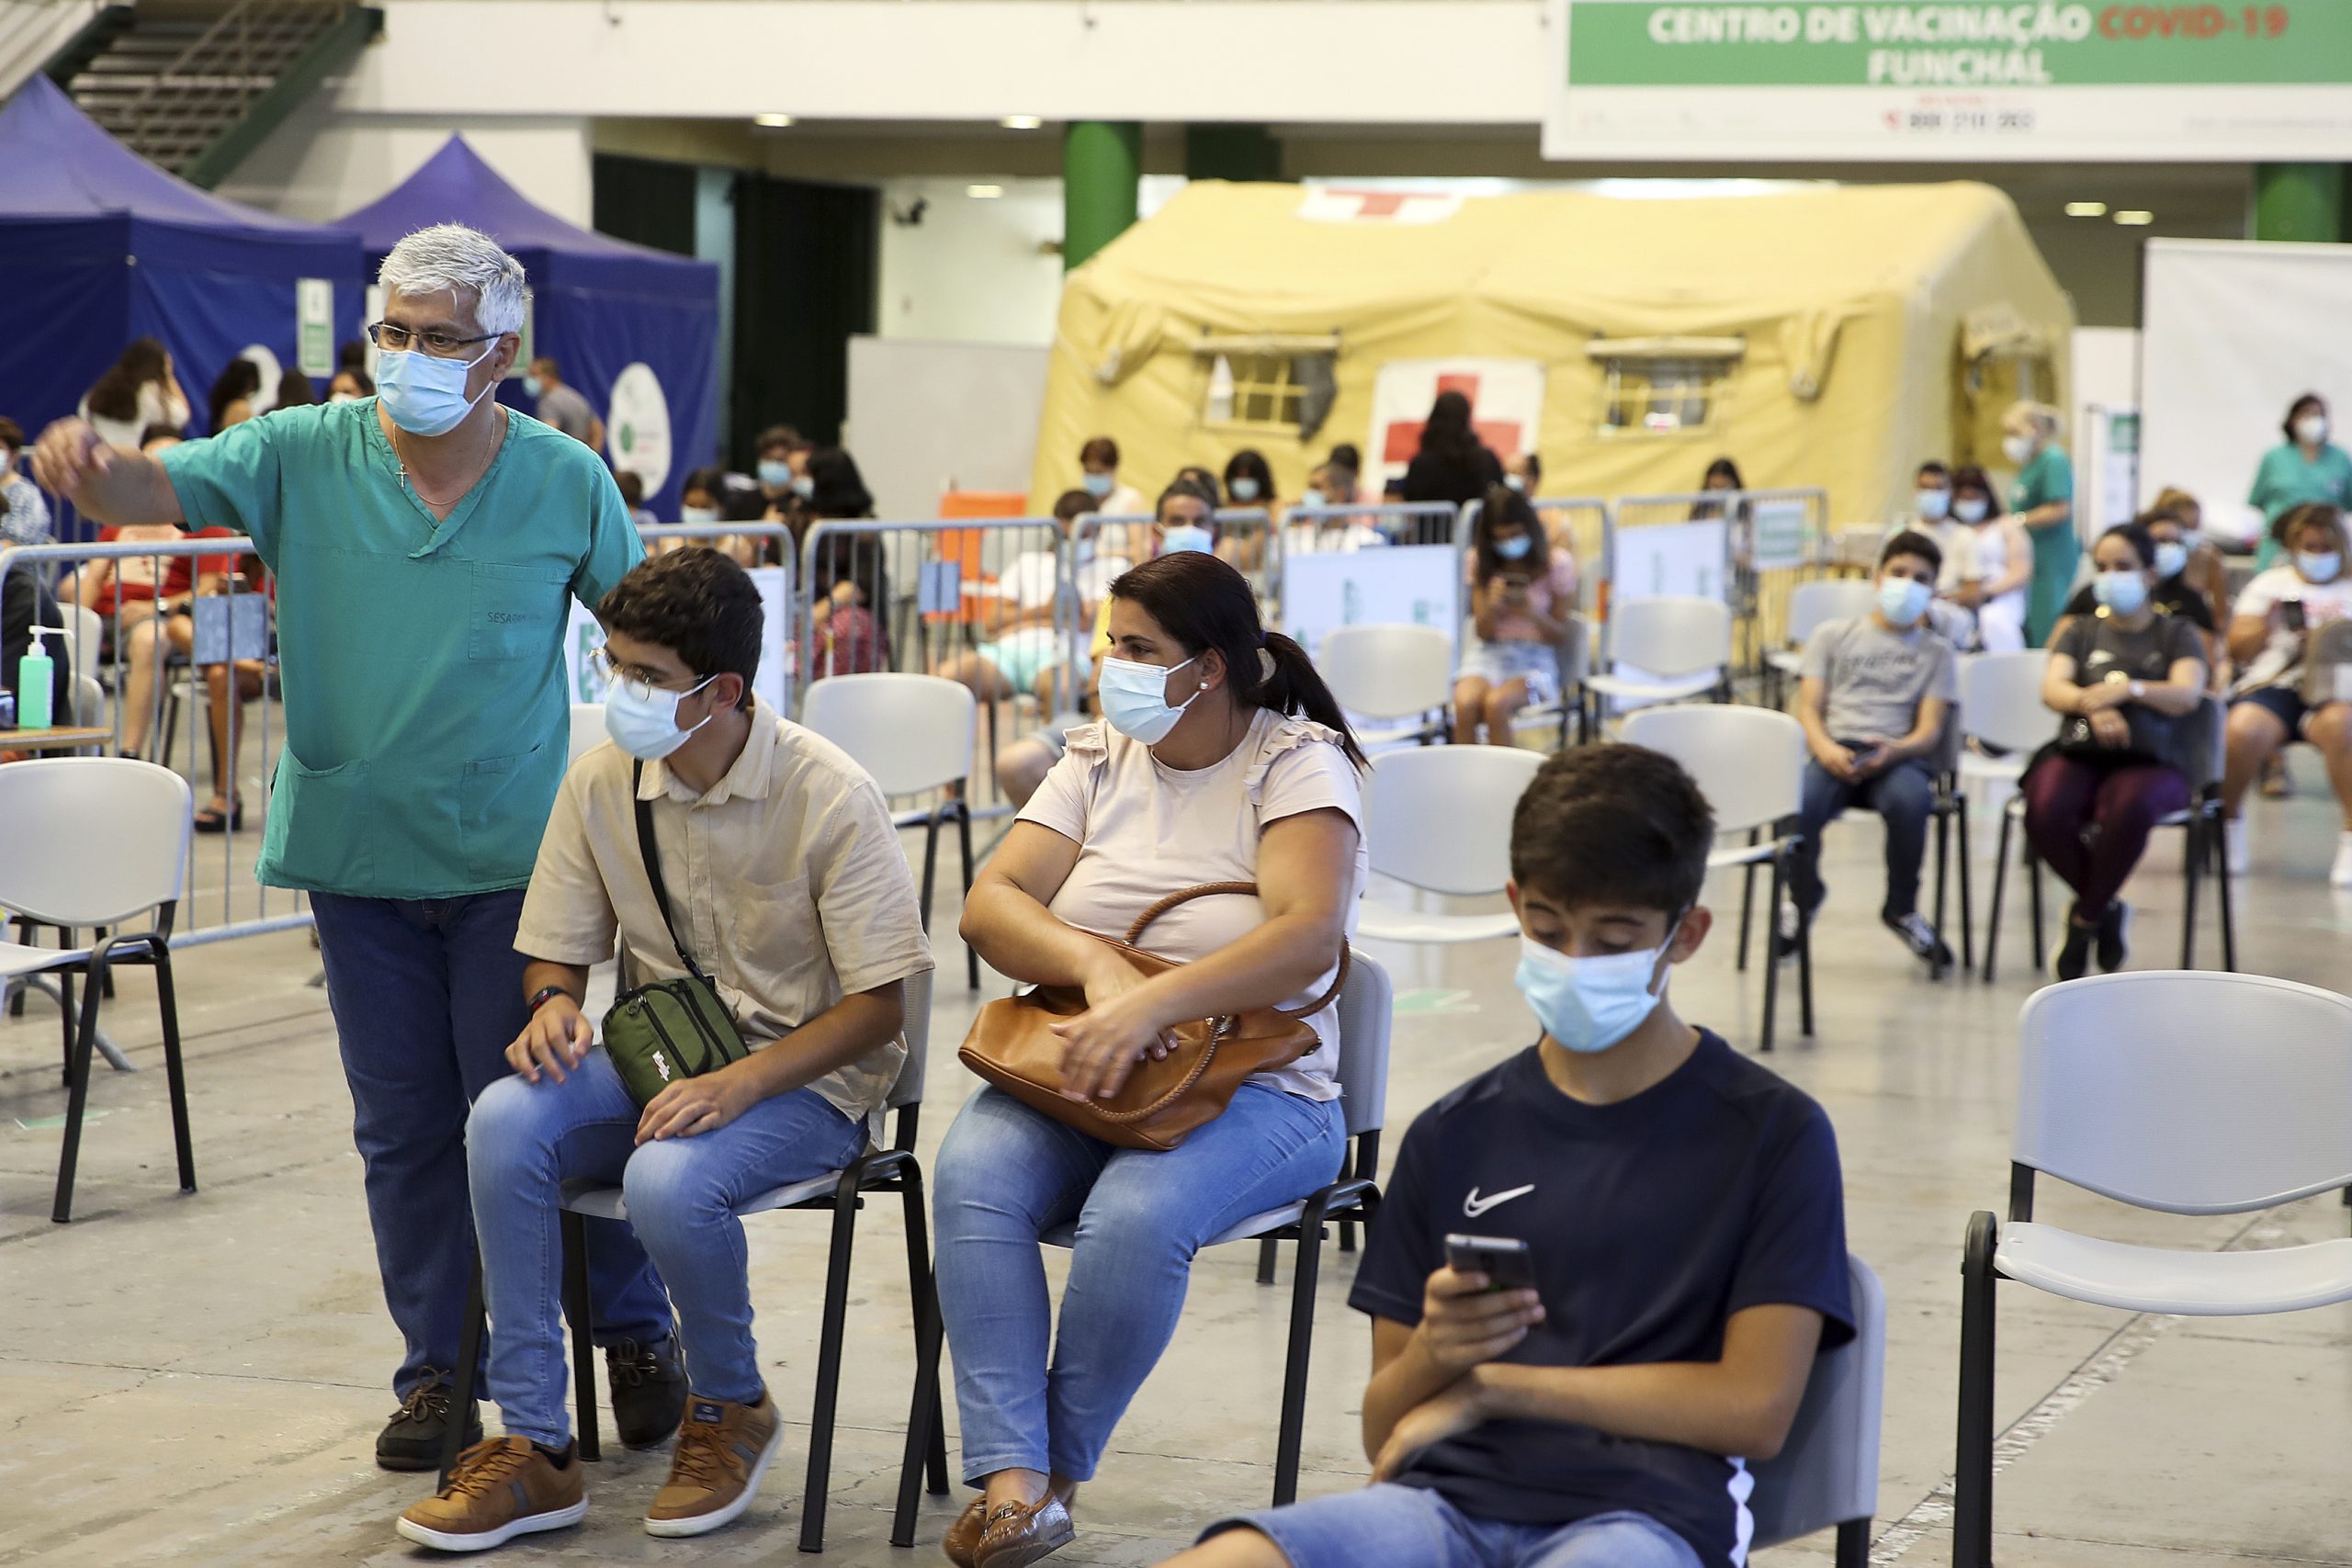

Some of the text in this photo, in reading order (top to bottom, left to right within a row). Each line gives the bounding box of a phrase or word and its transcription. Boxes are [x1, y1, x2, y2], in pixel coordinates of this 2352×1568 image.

[1648, 2, 2290, 49] CENTRO DE VACINAÇÃO COVID-19
[1867, 49, 2053, 85] FUNCHAL
